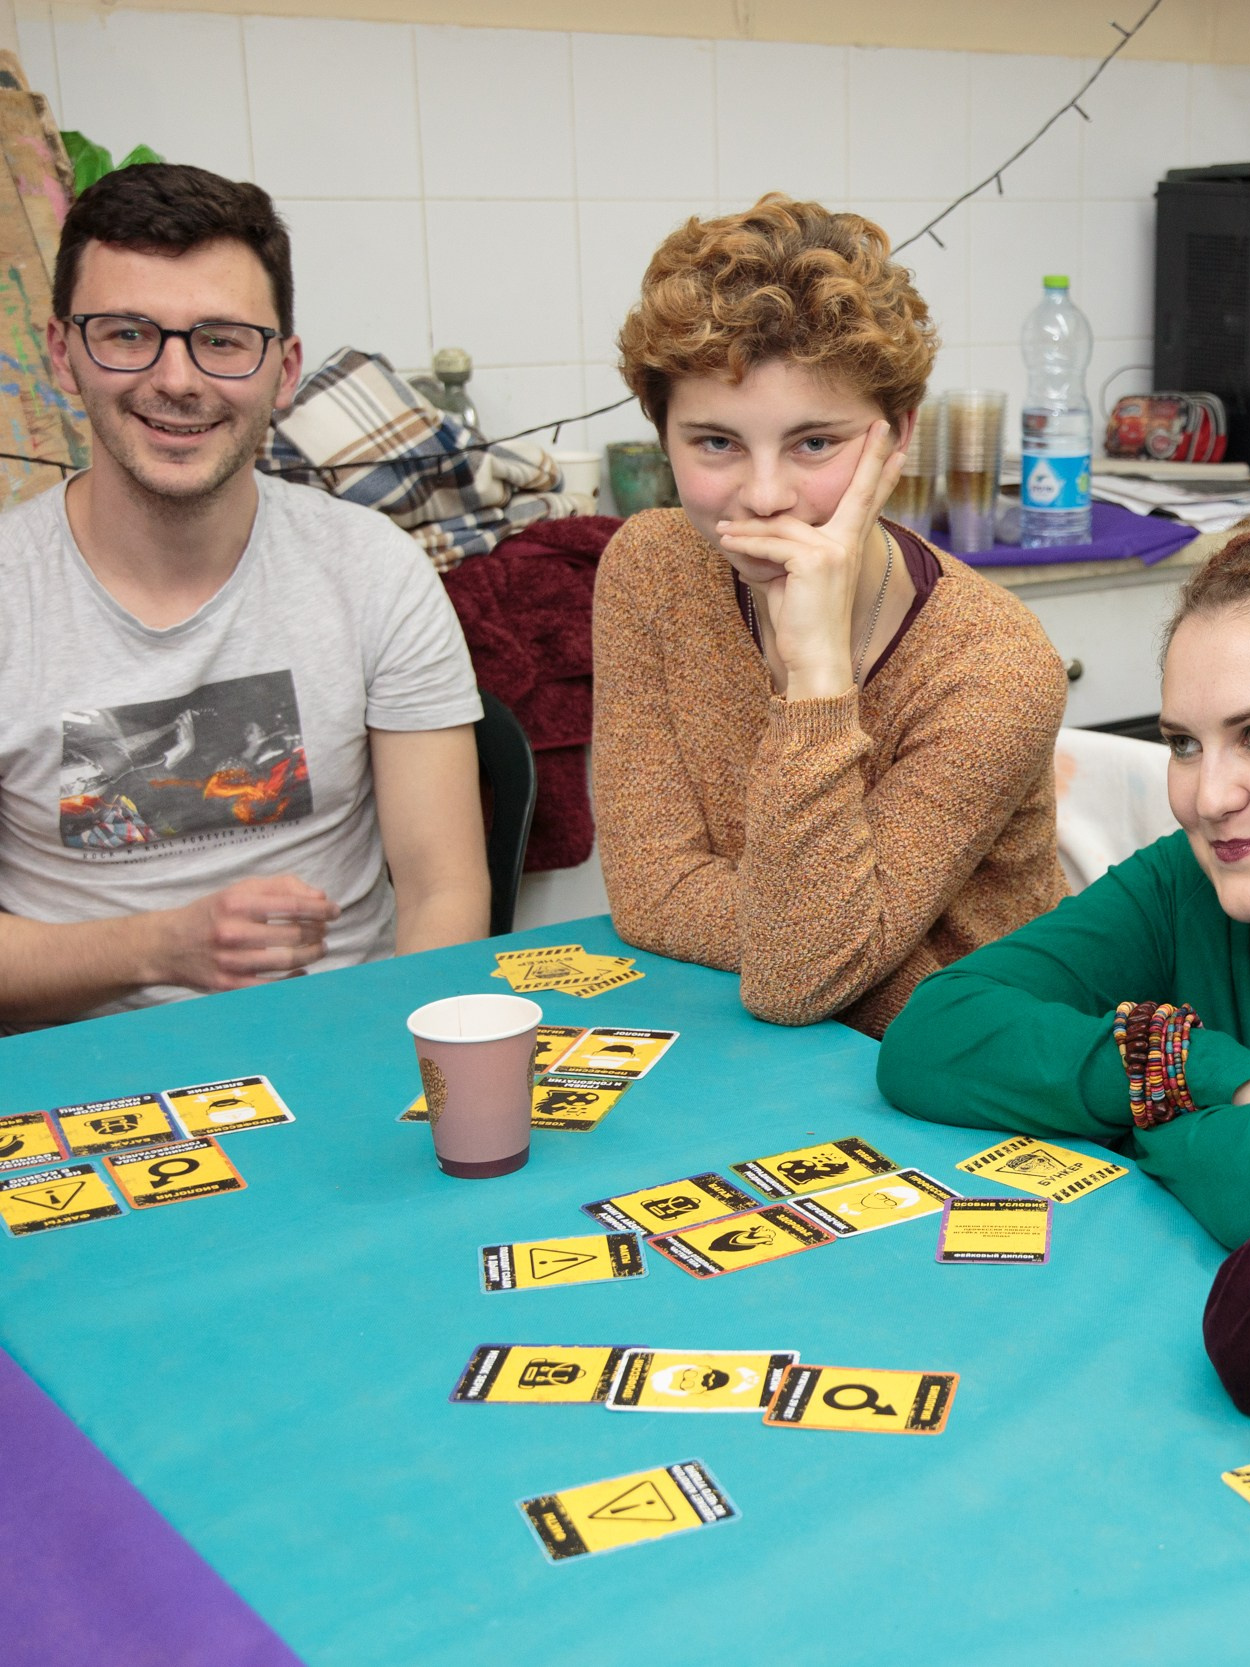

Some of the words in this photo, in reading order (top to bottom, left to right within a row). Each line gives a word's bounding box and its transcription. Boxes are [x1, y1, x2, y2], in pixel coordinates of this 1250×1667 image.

[517, 956, 573, 966] БУНКЕР
[567, 1067, 628, 1075] ПРОФЕССИЯ
[186, 1081, 244, 1094] ЭЛЕКТРИК
[73, 1101, 140, 1114] ИНКУБАТОР
[205, 1118, 274, 1133] ПРОФЕССИЯ
[110, 1138, 150, 1147] БАГАЖ
[157, 1142, 208, 1156] МУЖЧИНА
[114, 1156, 141, 1164] ГОДА
[853, 1149, 877, 1163] ХОББИ
[8, 1171, 58, 1184] КАЗИНО
[1036, 1161, 1087, 1186] БУНКЕР
[1, 1173, 62, 1190] ПУСКАЮТ
[907, 1175, 951, 1199] ПРОФЕССИЯ
[155, 1184, 219, 1200] БИОЛОГИЯ
[707, 1183, 733, 1198] БАГАЖ
[42, 1213, 91, 1226] ФАКТЫ
[801, 1201, 849, 1230] ПЕРЕВОДЧИК
[775, 1214, 814, 1236] ЗДОРОВЬЕ
[619, 1244, 630, 1264] ФАКТЫ
[621, 1358, 644, 1397] ПРОФЕССИЯ
[920, 1384, 940, 1420] БИОЛОГИЯ
[540, 1511, 569, 1542] ФАКТЫ
